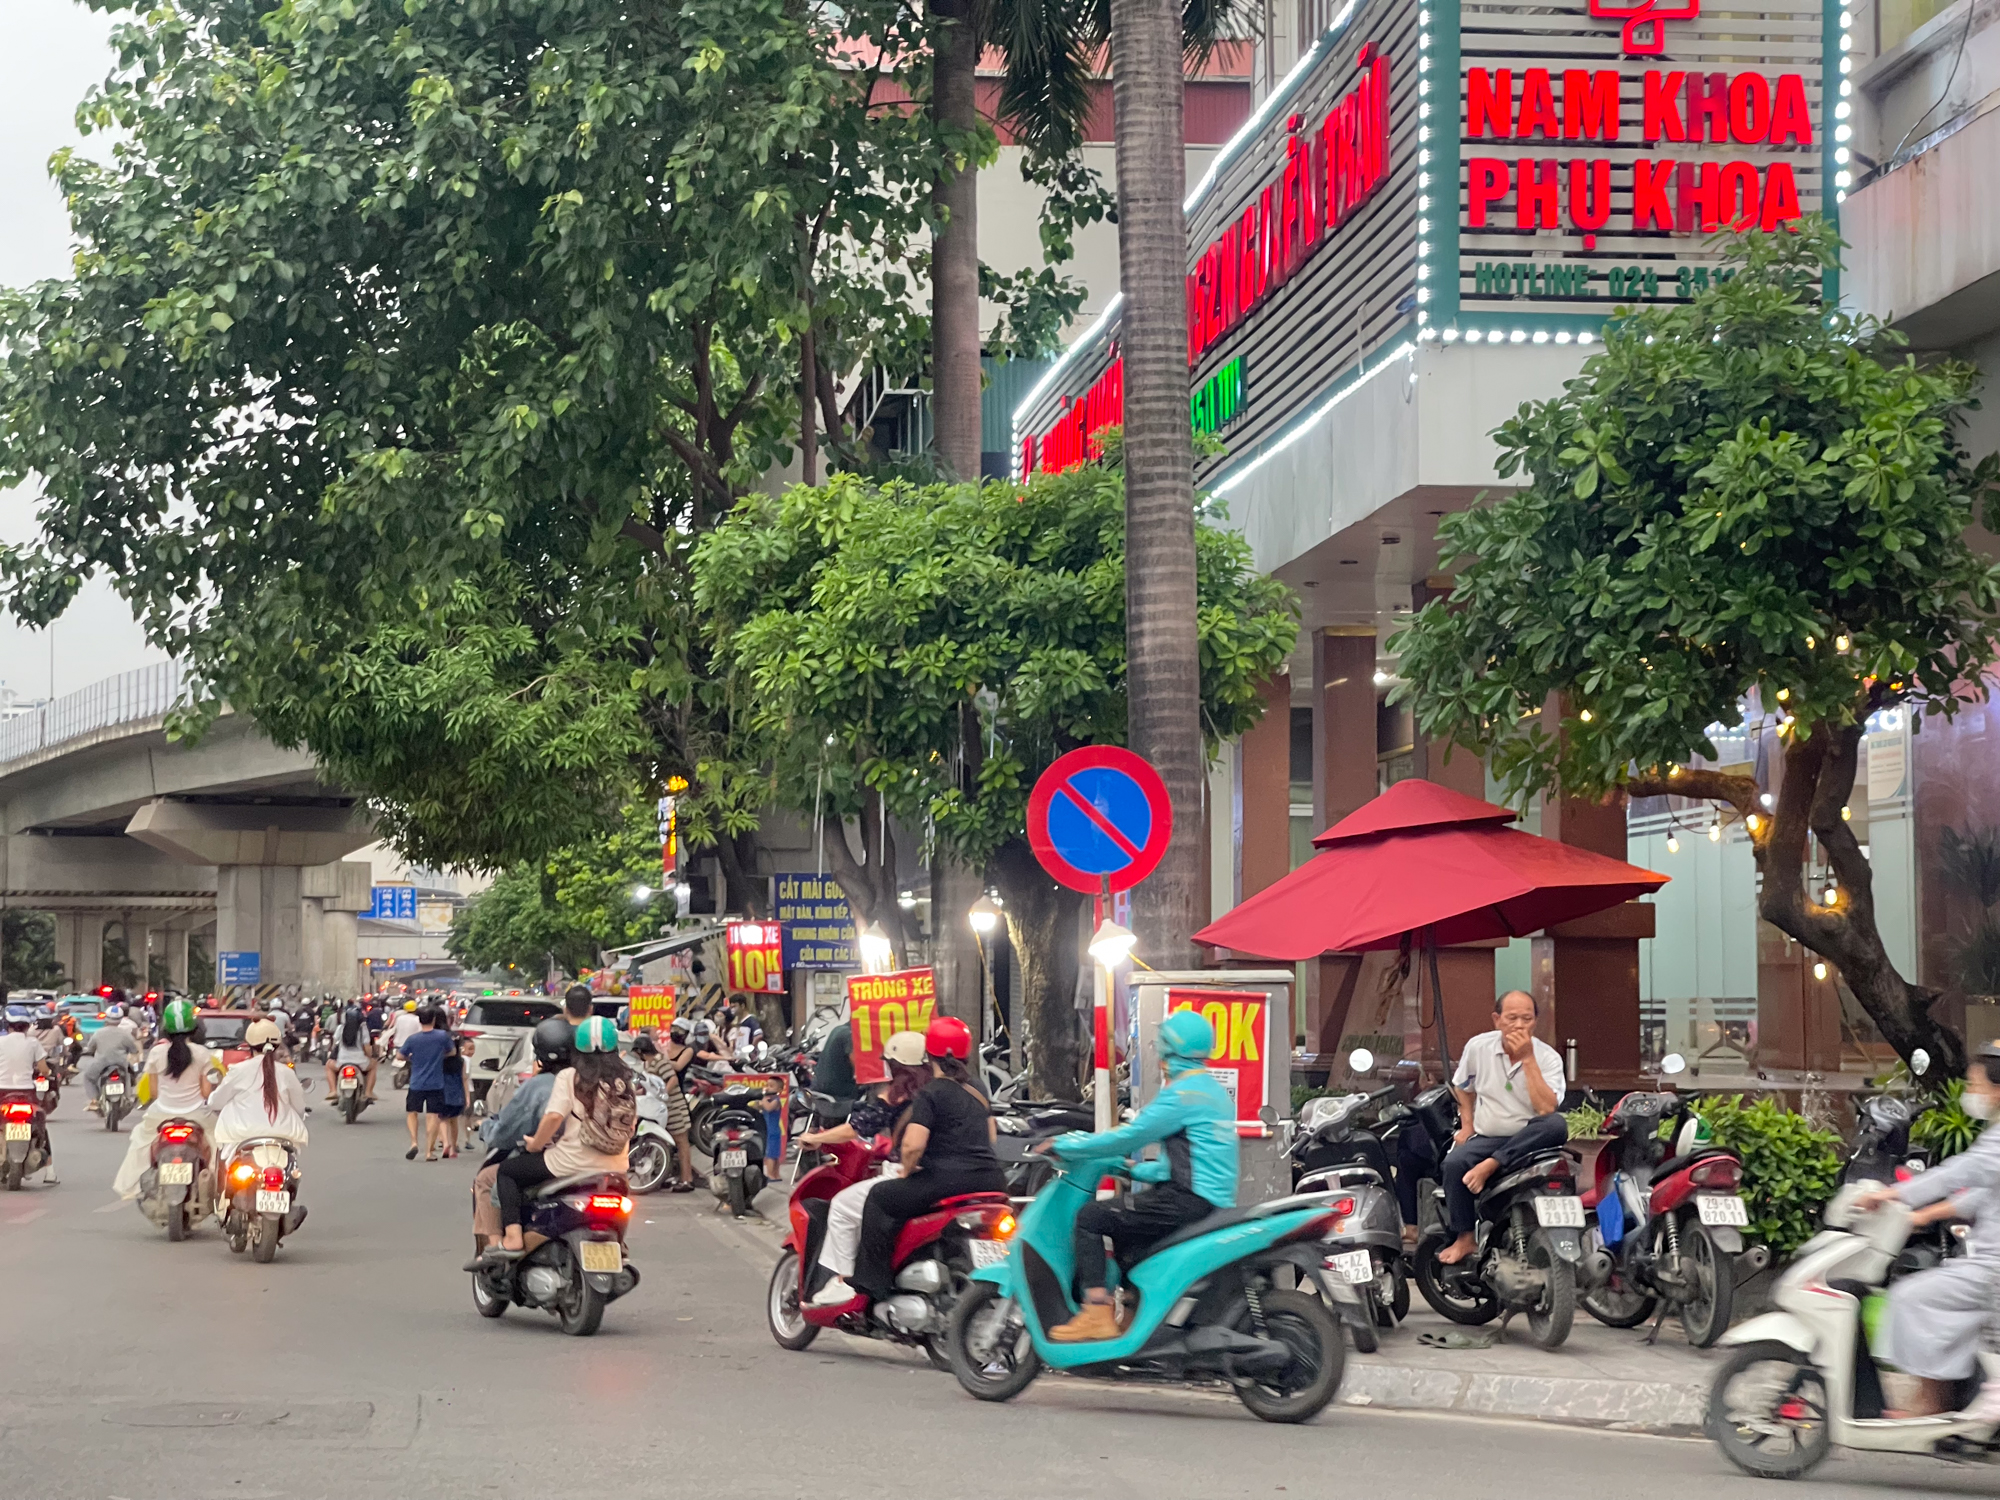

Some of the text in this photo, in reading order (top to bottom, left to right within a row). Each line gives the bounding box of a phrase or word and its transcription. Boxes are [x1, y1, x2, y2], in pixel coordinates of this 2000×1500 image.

[1467, 67, 1813, 145] NAM KHOA
[1468, 157, 1802, 250] PHỤ KHOA
[1475, 262, 1598, 297] HOTLINE:
[1608, 266, 1660, 298] 024
[764, 926, 780, 944] XE
[730, 949, 781, 989] 10K
[851, 976, 934, 1001] TRÔNG XE
[631, 993, 673, 1010] NƯỚC
[631, 1012, 660, 1029] MÍA
[852, 999, 936, 1052] 10K
[262, 1191, 285, 1201] 29-AA
[1545, 1212, 1577, 1224] 2937
